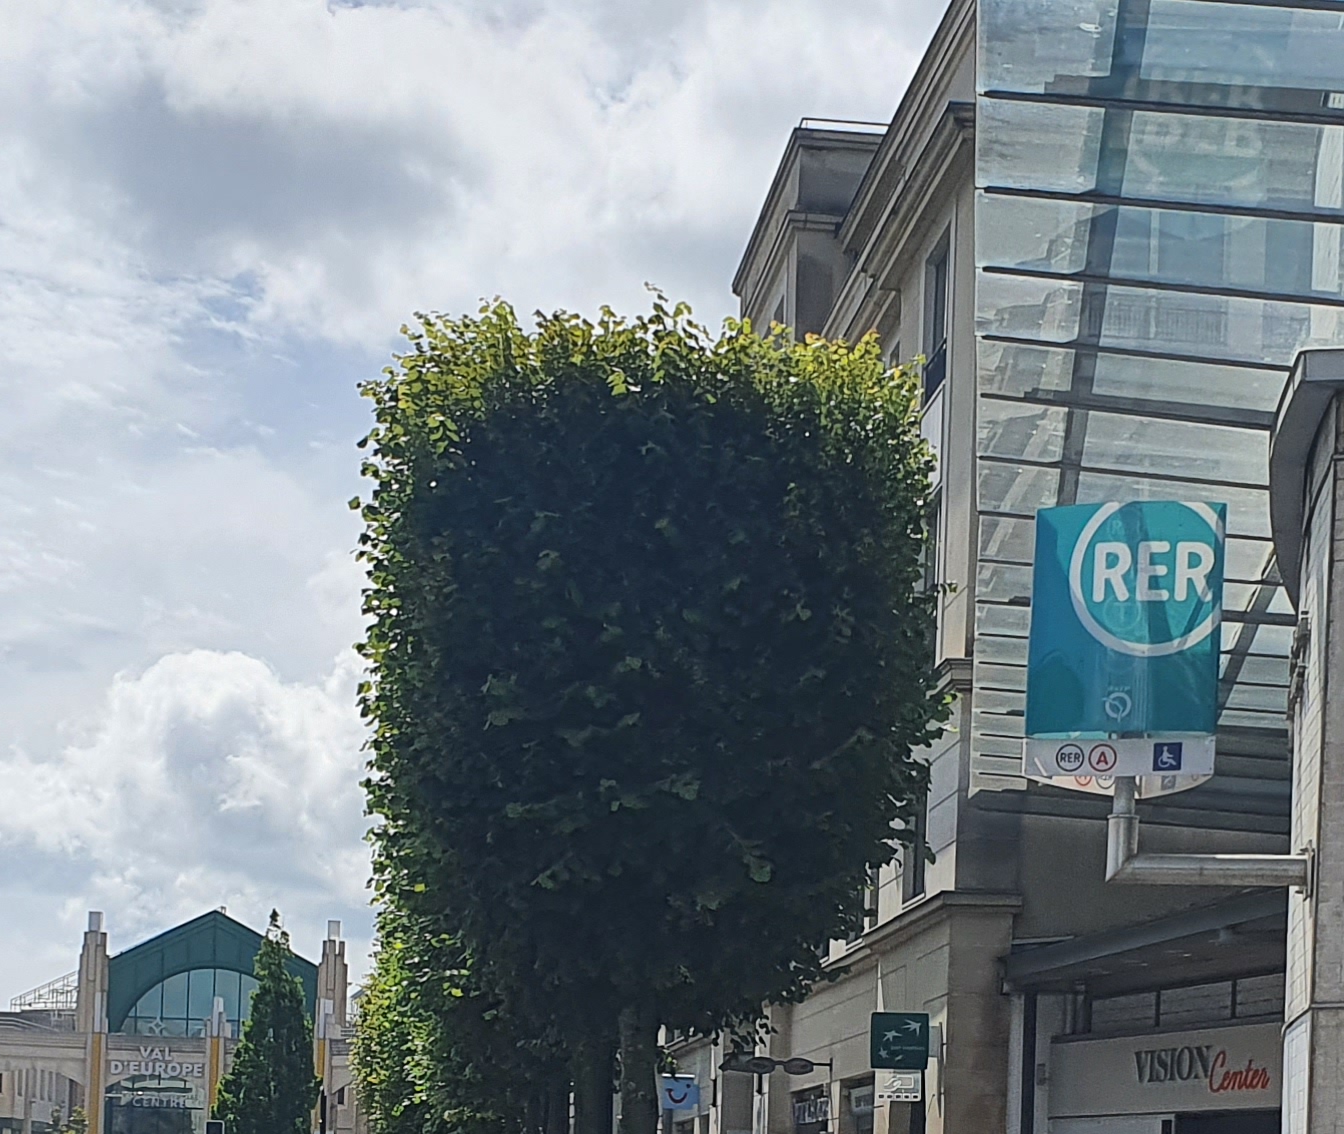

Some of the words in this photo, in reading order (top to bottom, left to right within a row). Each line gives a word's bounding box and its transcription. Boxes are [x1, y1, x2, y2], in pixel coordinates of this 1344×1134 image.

[1092, 541, 1215, 602] RER
[1060, 752, 1081, 764] RER
[1096, 751, 1108, 765] A
[139, 1046, 172, 1061] VAL
[110, 1060, 203, 1078] D'EUROPE
[1134, 1045, 1213, 1083] VISION
[1209, 1050, 1270, 1093] Center
[132, 1096, 187, 1108] CENTRE
